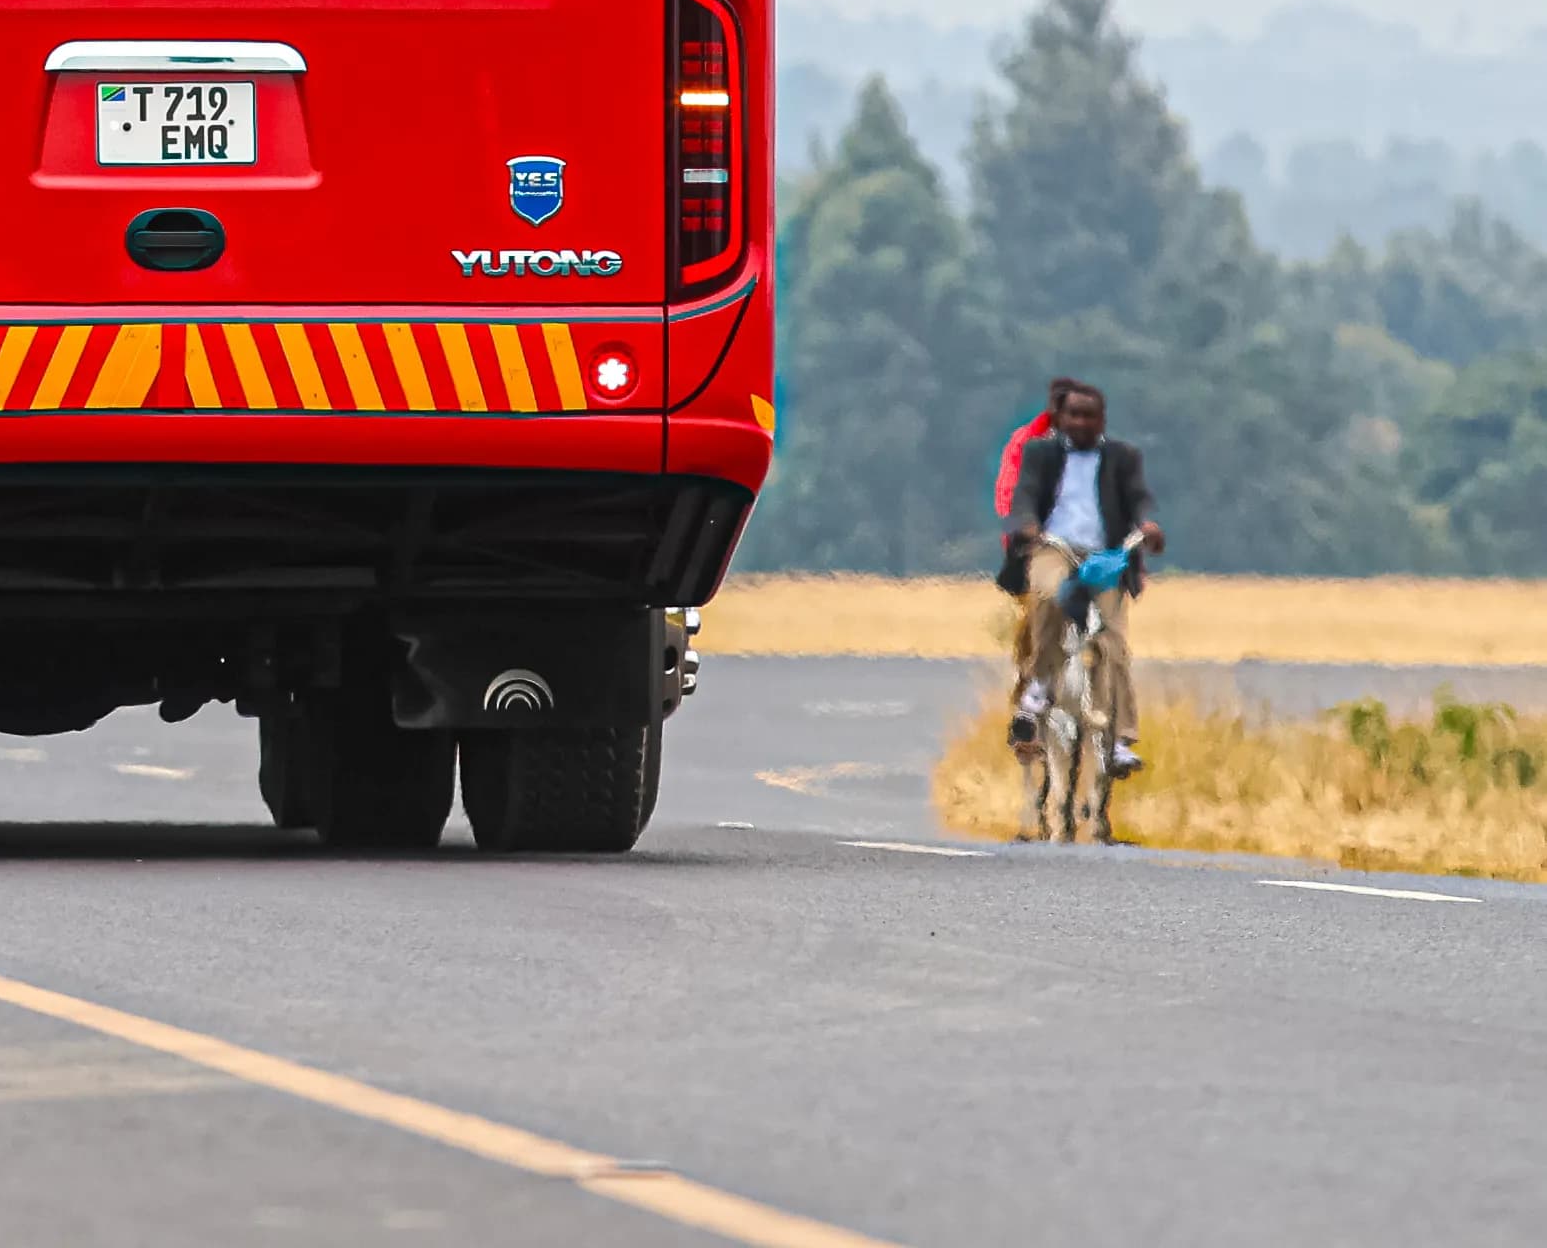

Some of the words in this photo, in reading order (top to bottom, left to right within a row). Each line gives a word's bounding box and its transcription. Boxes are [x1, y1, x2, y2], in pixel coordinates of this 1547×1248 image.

[132, 86, 154, 122] T
[164, 86, 228, 122] 719
[161, 124, 228, 160] EMQ
[450, 249, 623, 277] YUTONG
